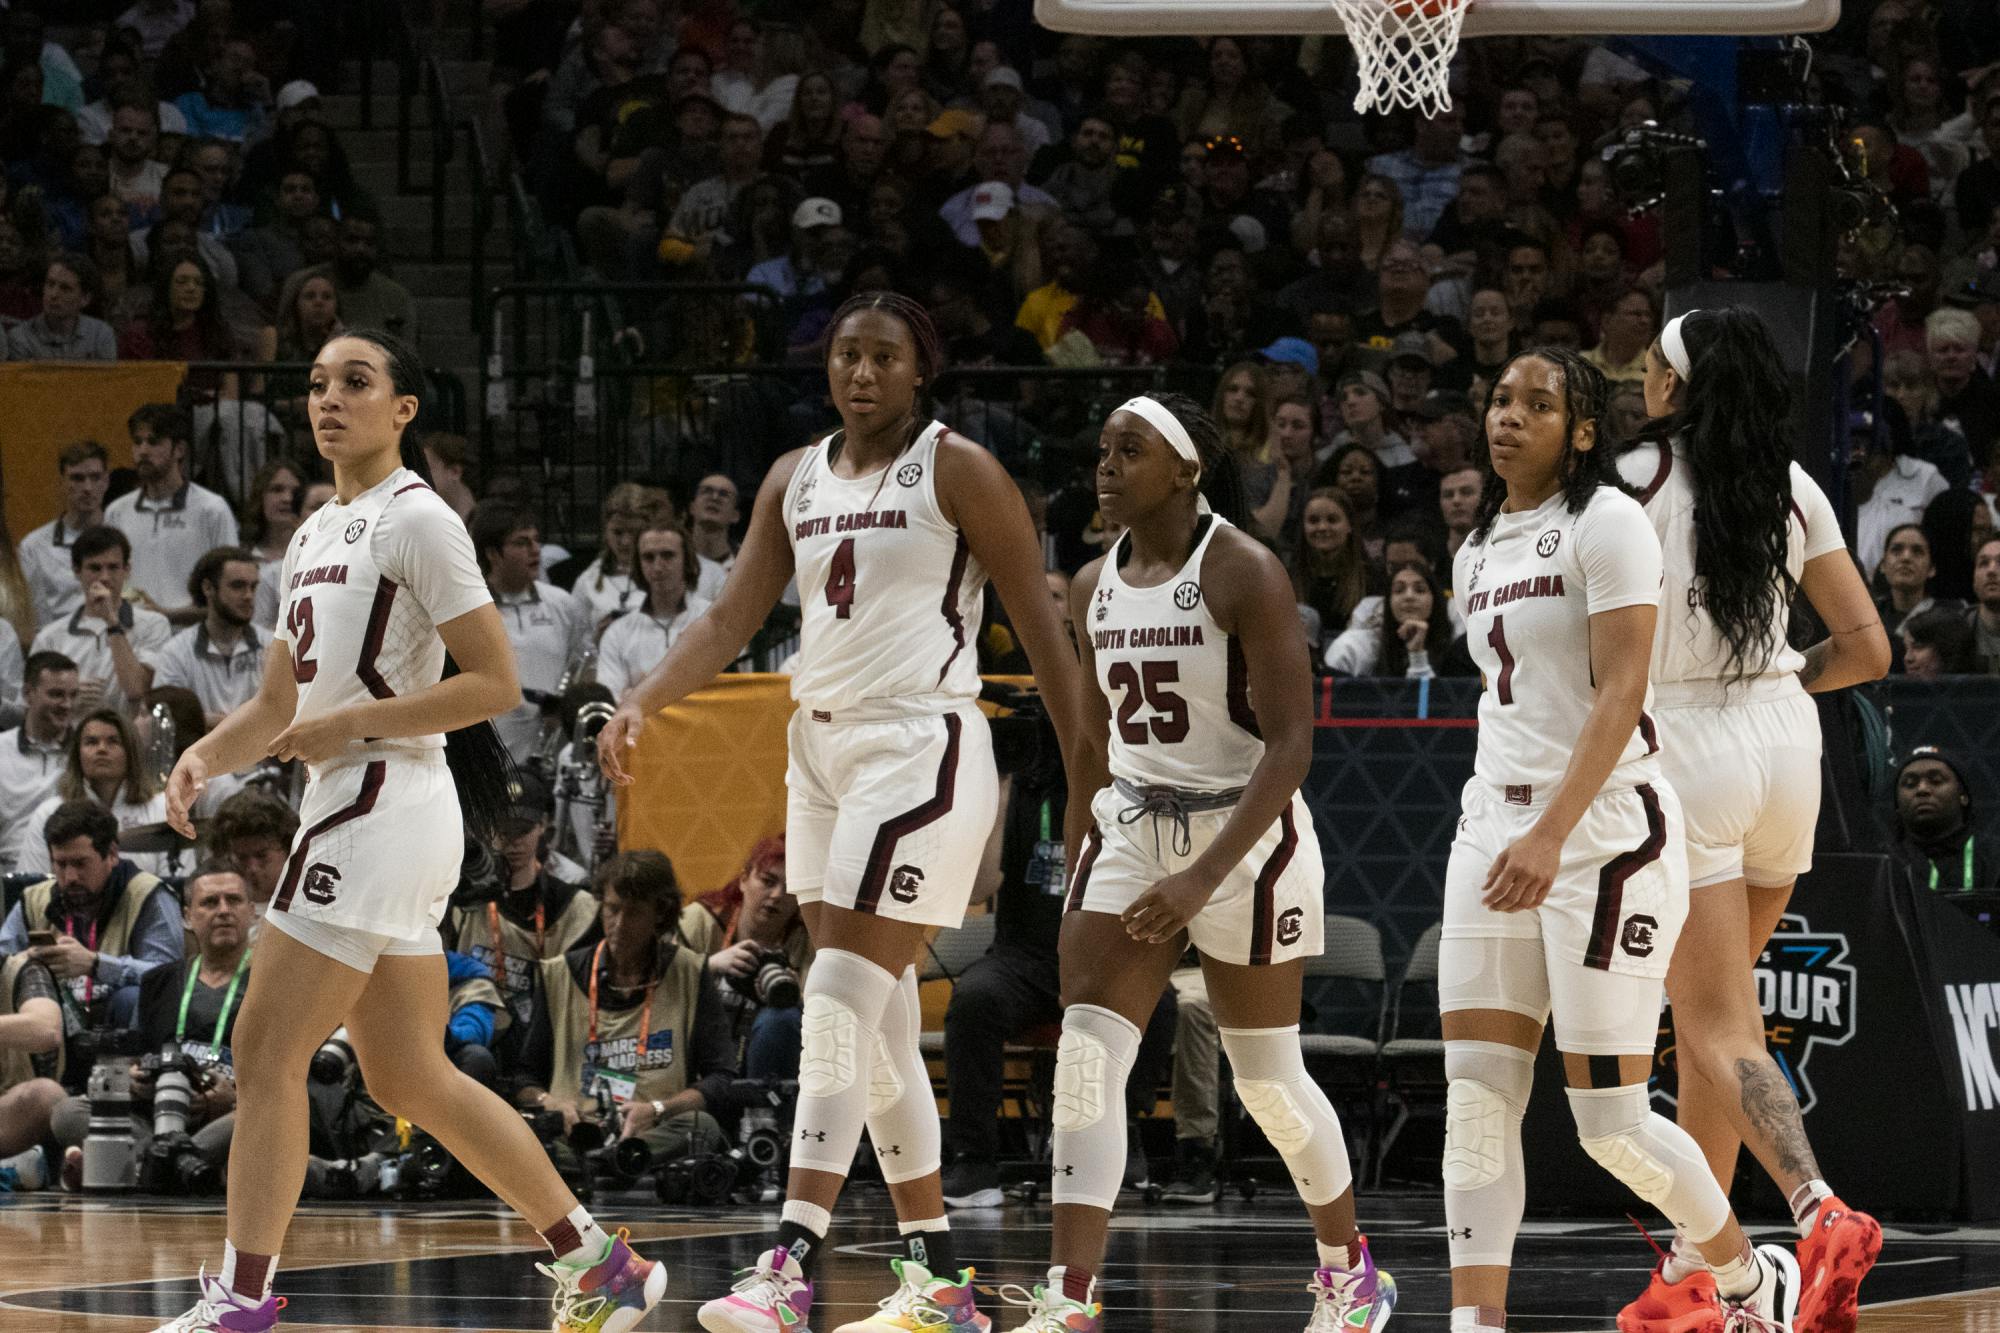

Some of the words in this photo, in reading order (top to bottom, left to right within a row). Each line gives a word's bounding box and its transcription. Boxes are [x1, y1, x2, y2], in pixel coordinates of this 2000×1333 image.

[898, 464, 922, 487] SEC
[795, 516, 831, 541] SOUTH
[835, 510, 908, 533] CAROLINA
[1538, 530, 1560, 557] SEC
[824, 538, 857, 619] 4
[1493, 575, 1565, 607] CAROLINA
[1174, 582, 1200, 610] SEC
[1129, 625, 1204, 648] CAROLINA
[1487, 614, 1514, 706] 1
[1107, 660, 1190, 744] 25
[1752, 968, 1841, 1026] OUR
[601, 1038, 641, 1058] MARC
[1944, 983, 2000, 1111] NC
